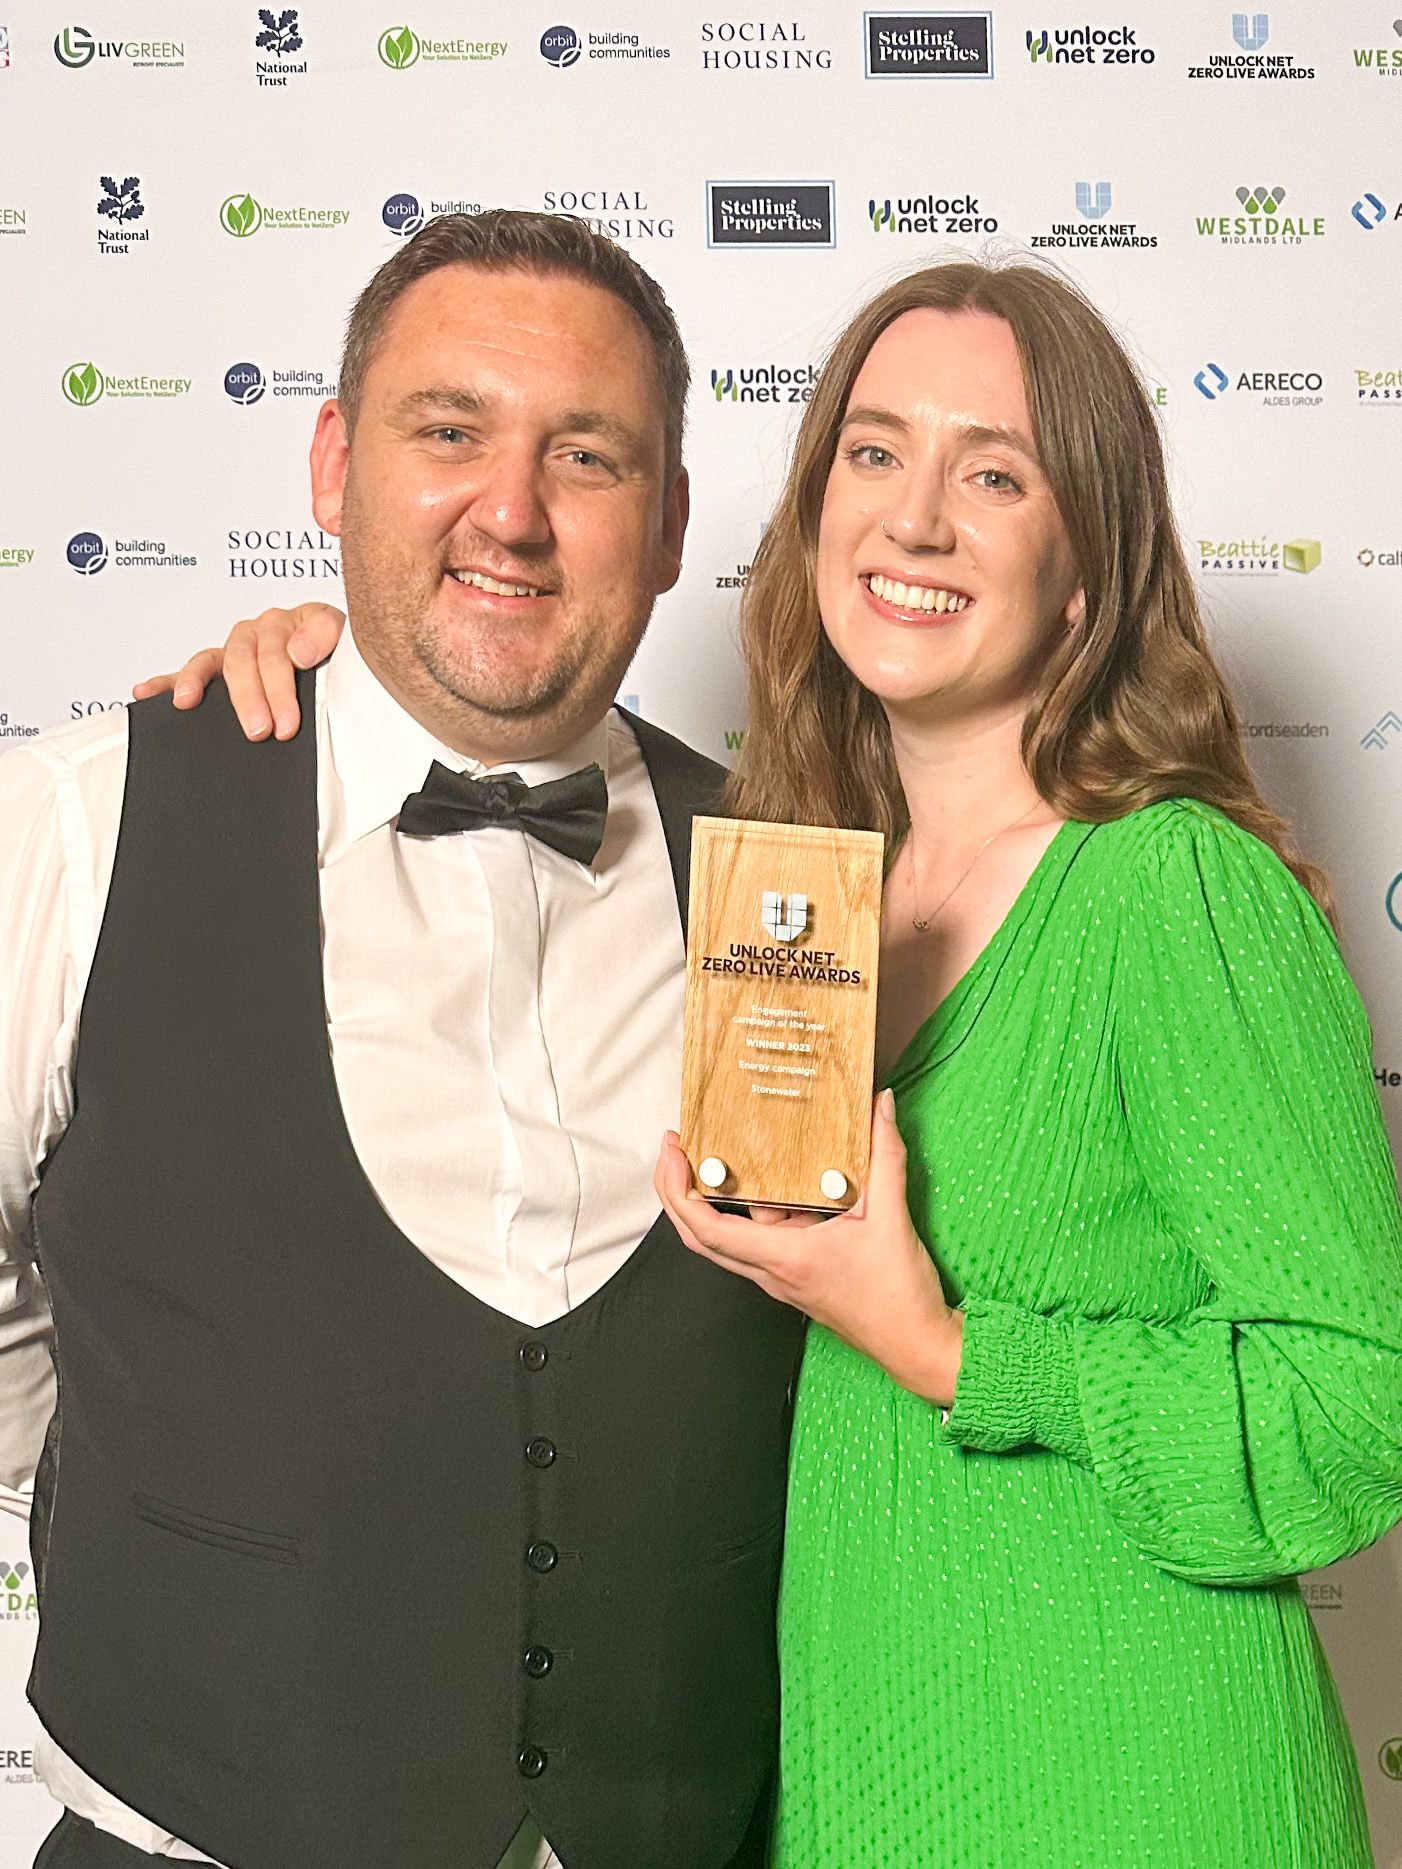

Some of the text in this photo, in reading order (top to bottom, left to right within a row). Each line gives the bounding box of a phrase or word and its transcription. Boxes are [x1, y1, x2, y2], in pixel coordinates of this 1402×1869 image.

[589, 33, 638, 46] building
[702, 23, 805, 41] SOCIAL
[879, 30, 957, 48] Stelling
[1055, 26, 1136, 45] unlock
[422, 40, 507, 56] NextEnergy
[545, 34, 574, 47] orbit
[99, 43, 183, 57] LIVGREEN
[589, 46, 670, 58] communities
[880, 45, 979, 64] Properties
[1056, 46, 1155, 64] net zero
[704, 50, 831, 68] HOUSING
[1209, 56, 1294, 67] UNLOCK NET
[256, 62, 306, 74] National
[1188, 68, 1315, 78] ZERO LIVE AWARDS
[256, 75, 287, 85] Trust
[432, 201, 481, 216] building
[544, 192, 647, 210] SOCIAL
[721, 199, 800, 217] Stelling
[898, 195, 978, 216] unlock
[264, 208, 349, 224] NextEnergy
[386, 204, 417, 215] orbit
[587, 219, 675, 239] USING
[723, 214, 821, 233] Properties
[899, 215, 998, 233] net zero
[1052, 225, 1136, 235] UNLOCK NET
[1196, 218, 1324, 238] WESTDALE
[98, 229, 148, 240] National
[1031, 237, 1157, 247] ZERO LIVE AWARDS
[98, 242, 128, 253] Trust
[228, 373, 258, 385] orbit
[273, 370, 323, 384] building
[740, 365, 822, 384] unlock
[1237, 373, 1322, 390] AERECO
[106, 377, 191, 392] NextEnergy
[272, 384, 336, 398] communit
[741, 387, 815, 403] net ze
[1263, 397, 1323, 406] ALDES GROUP
[229, 529, 334, 549] SOCIAL
[70, 542, 101, 554] orbit
[116, 540, 165, 554] building
[1198, 536, 1279, 558] Beattie
[116, 553, 197, 566] communities
[1202, 560, 1278, 569] PASSIVE
[229, 557, 339, 578] HOUSIN
[730, 943, 835, 966] UNLOCK NET
[702, 956, 861, 984] ZERO LIVE AWARDS
[746, 1038, 811, 1053] WINNER 2023
